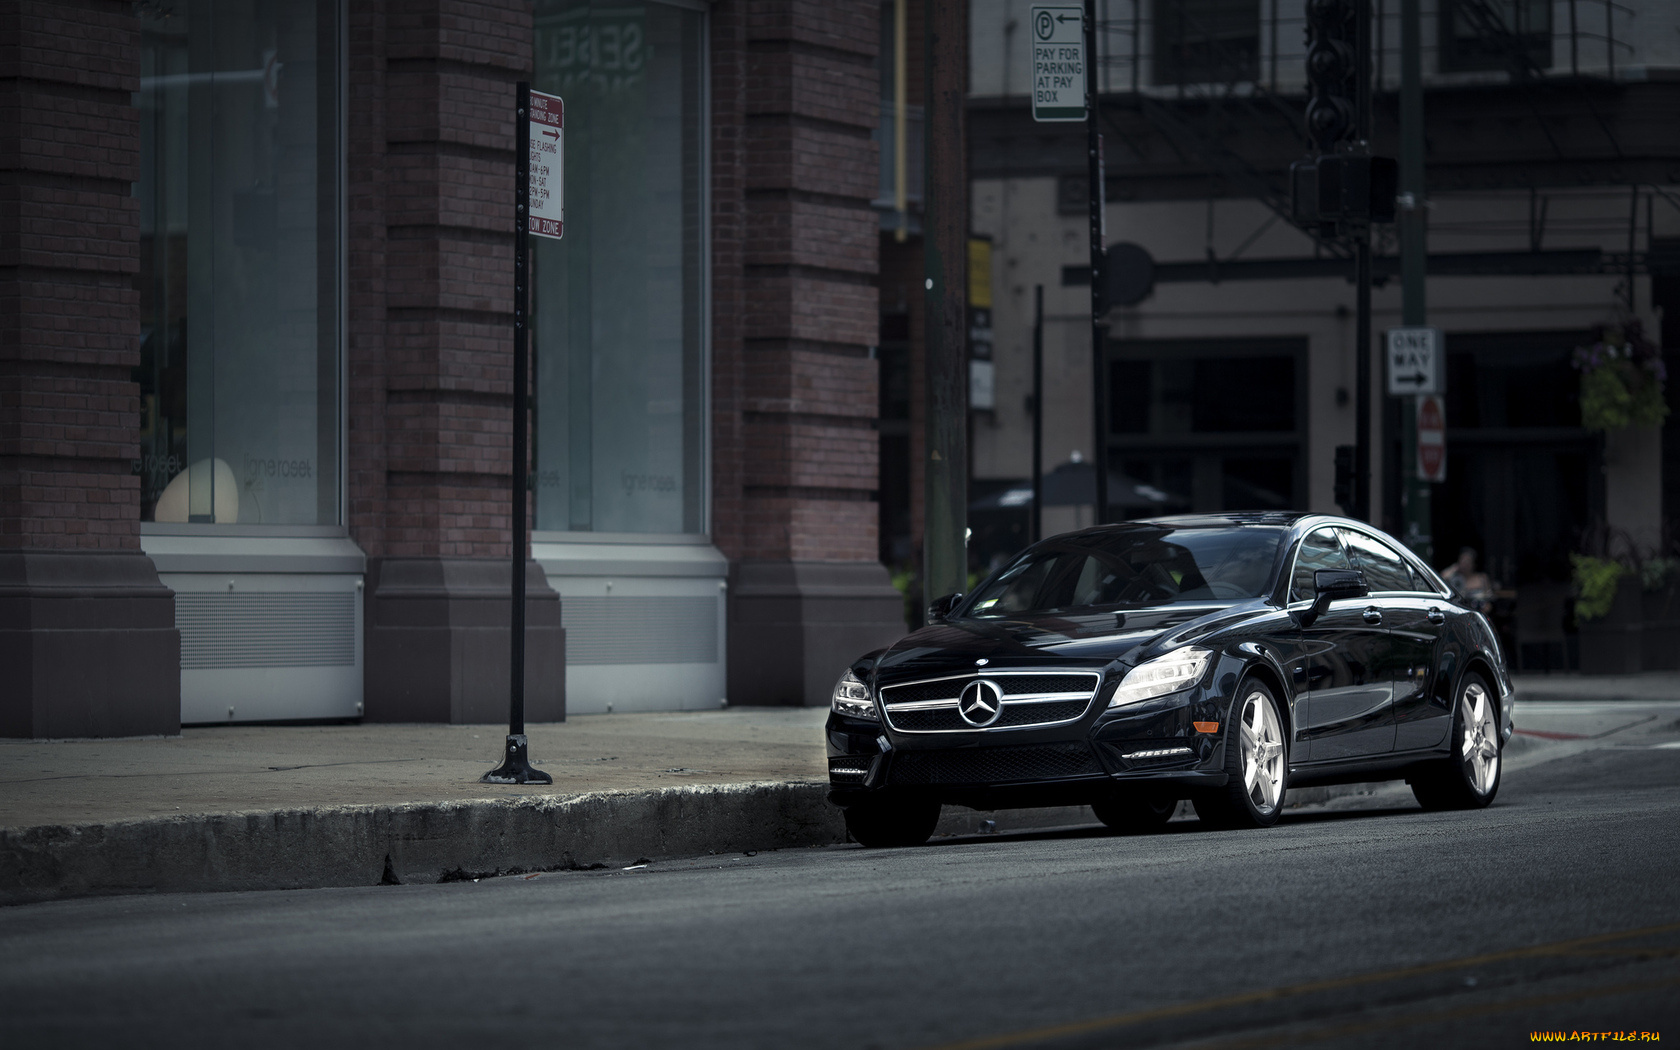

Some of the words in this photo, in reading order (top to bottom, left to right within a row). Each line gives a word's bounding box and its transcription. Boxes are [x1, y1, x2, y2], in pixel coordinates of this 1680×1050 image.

[1040, 16, 1050, 35] P
[1035, 47, 1056, 60] PAY
[1058, 47, 1080, 60] FOR
[1036, 61, 1083, 75] PARKING
[1037, 76, 1051, 89] AT
[1053, 75, 1074, 89] PAY
[533, 97, 548, 110] MINUTE
[1037, 89, 1059, 103] BOX
[530, 108, 547, 122] TANDING
[547, 112, 559, 125] ZONE
[536, 140, 557, 155] FLASHING
[530, 162, 550, 177] 0AM-6PM
[530, 186, 550, 200] 2PM-5PM
[542, 219, 560, 235] ZONE
[1393, 333, 1428, 350] ONE
[1393, 353, 1431, 368] WAY
[277, 458, 312, 478] roset
